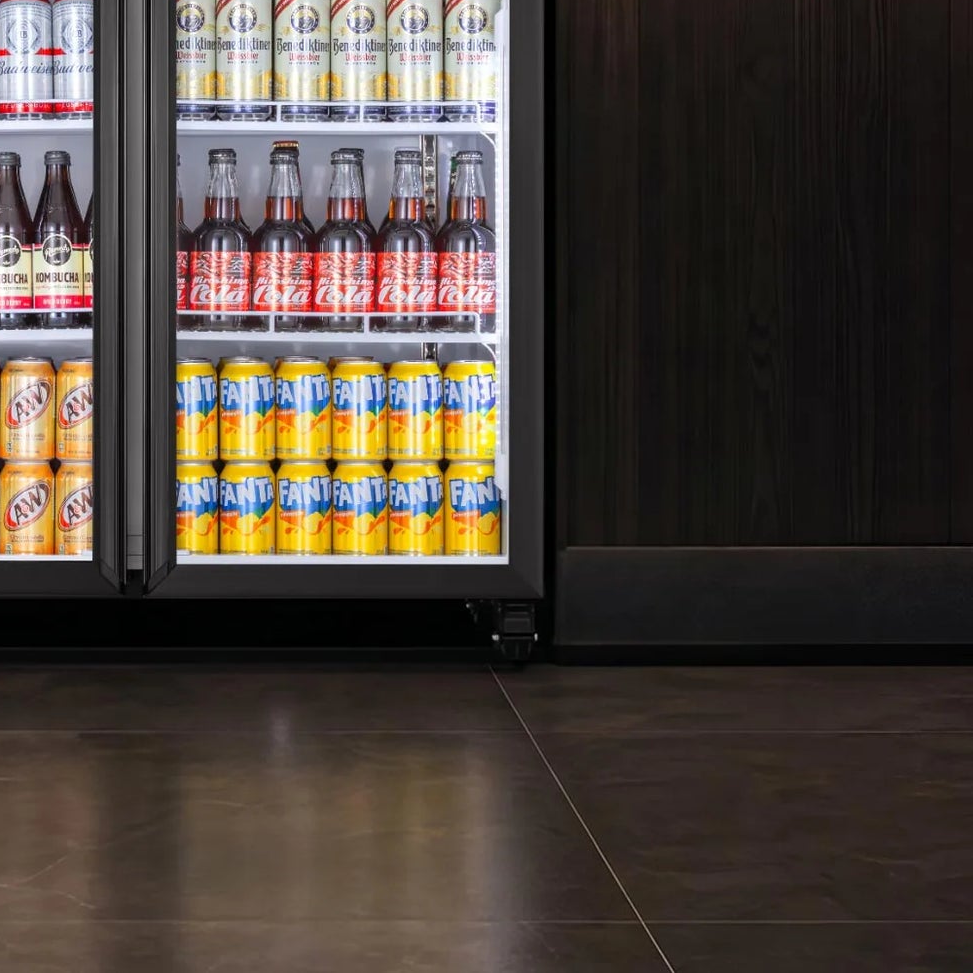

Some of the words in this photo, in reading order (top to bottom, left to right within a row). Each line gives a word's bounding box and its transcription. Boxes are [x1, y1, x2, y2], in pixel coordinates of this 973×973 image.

[446, 38, 496, 56] Benediktin
[35, 272, 79, 283] KOMBUCHA
[190, 284, 248, 304] Cola
[254, 284, 312, 304] Cola
[315, 284, 374, 304] Cola
[378, 284, 436, 304] Cola
[438, 284, 496, 304] Cola
[176, 375, 217, 403] ANT
[176, 477, 217, 507] ANT
